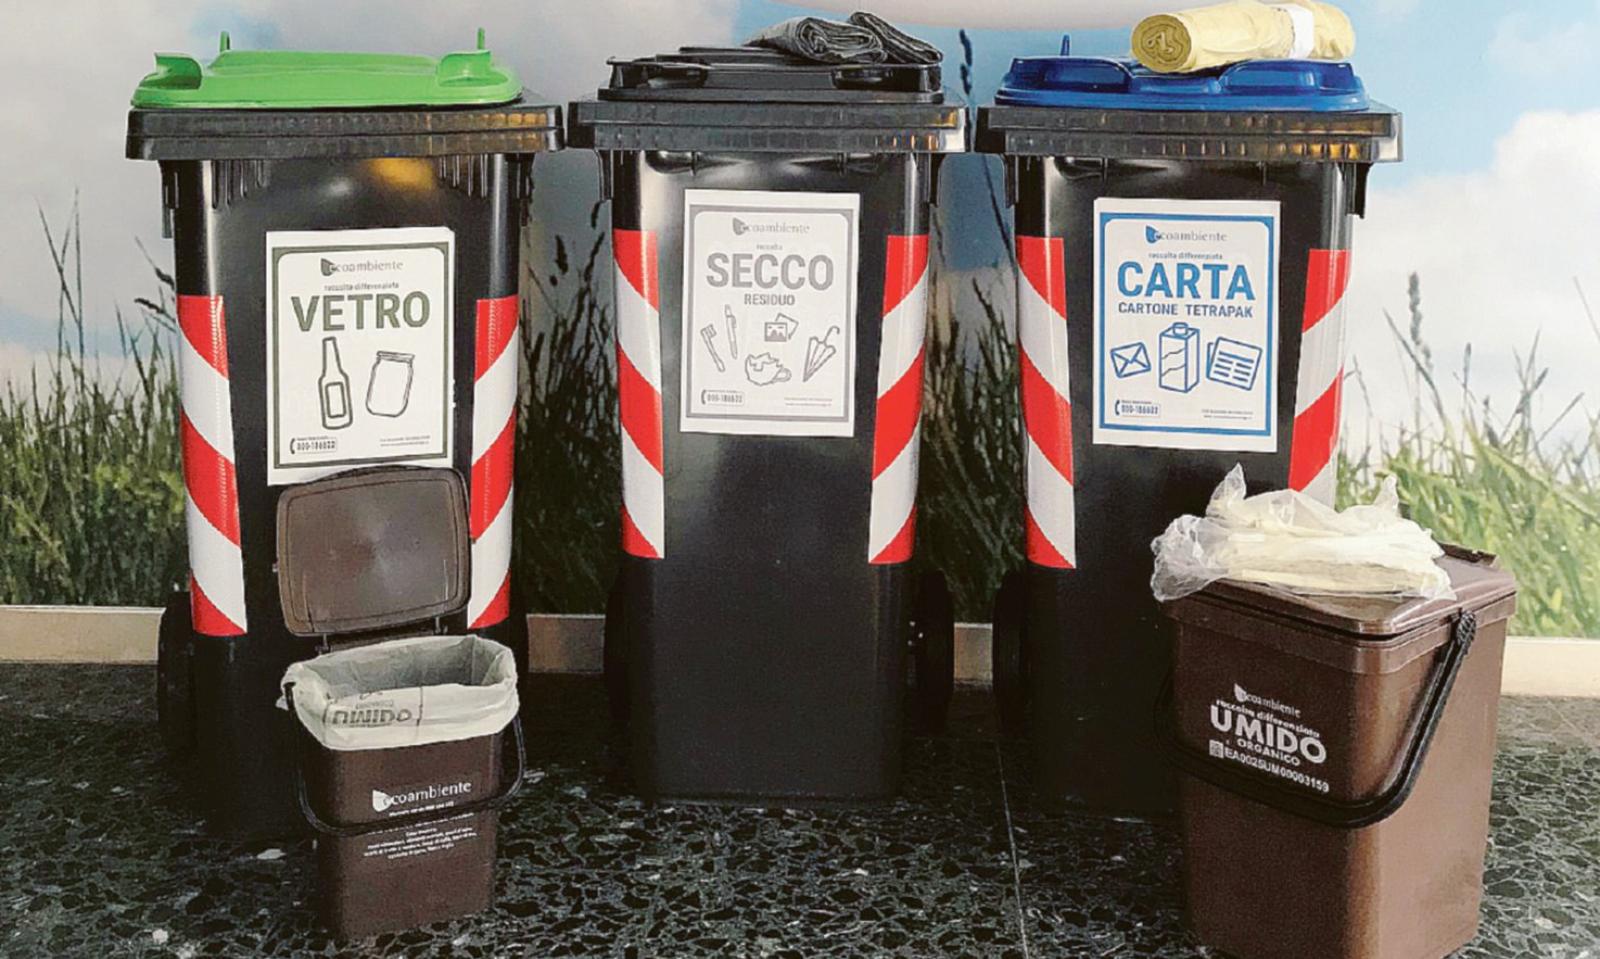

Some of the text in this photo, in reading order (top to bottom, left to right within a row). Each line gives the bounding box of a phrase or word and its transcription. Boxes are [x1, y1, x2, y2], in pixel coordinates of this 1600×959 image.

[706, 252, 834, 291] SECCO
[1117, 261, 1256, 301] CARTA
[291, 291, 430, 332] VETRO
[744, 293, 795, 306] RESIDUO
[1118, 301, 1253, 318] CARTONE TETRAPAK
[1210, 704, 1326, 764] UMIDO
[1237, 738, 1301, 767] ORGANICO
